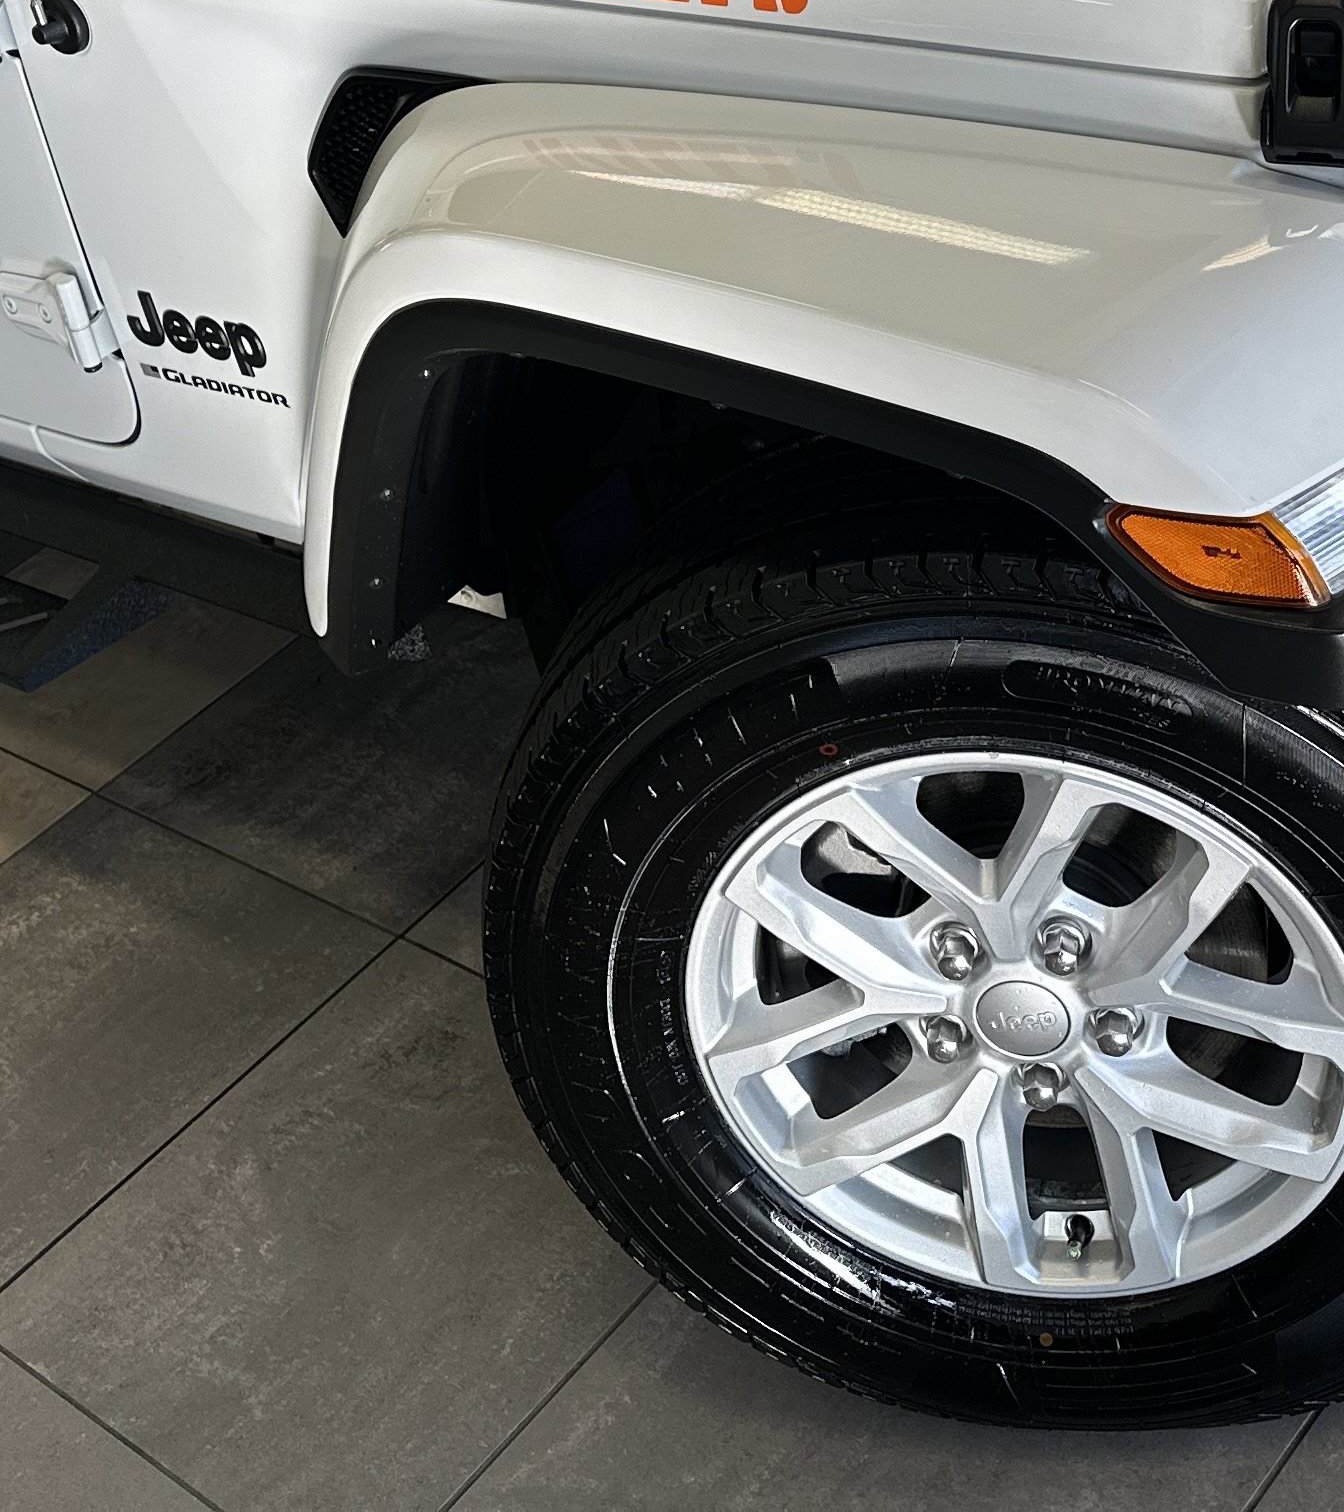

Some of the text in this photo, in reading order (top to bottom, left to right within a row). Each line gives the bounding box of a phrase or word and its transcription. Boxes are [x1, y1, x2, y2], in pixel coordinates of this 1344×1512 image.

[127, 290, 267, 377] Jeep
[162, 368, 291, 408] GLADIATOR
[991, 1011, 1057, 1032] Jeep
